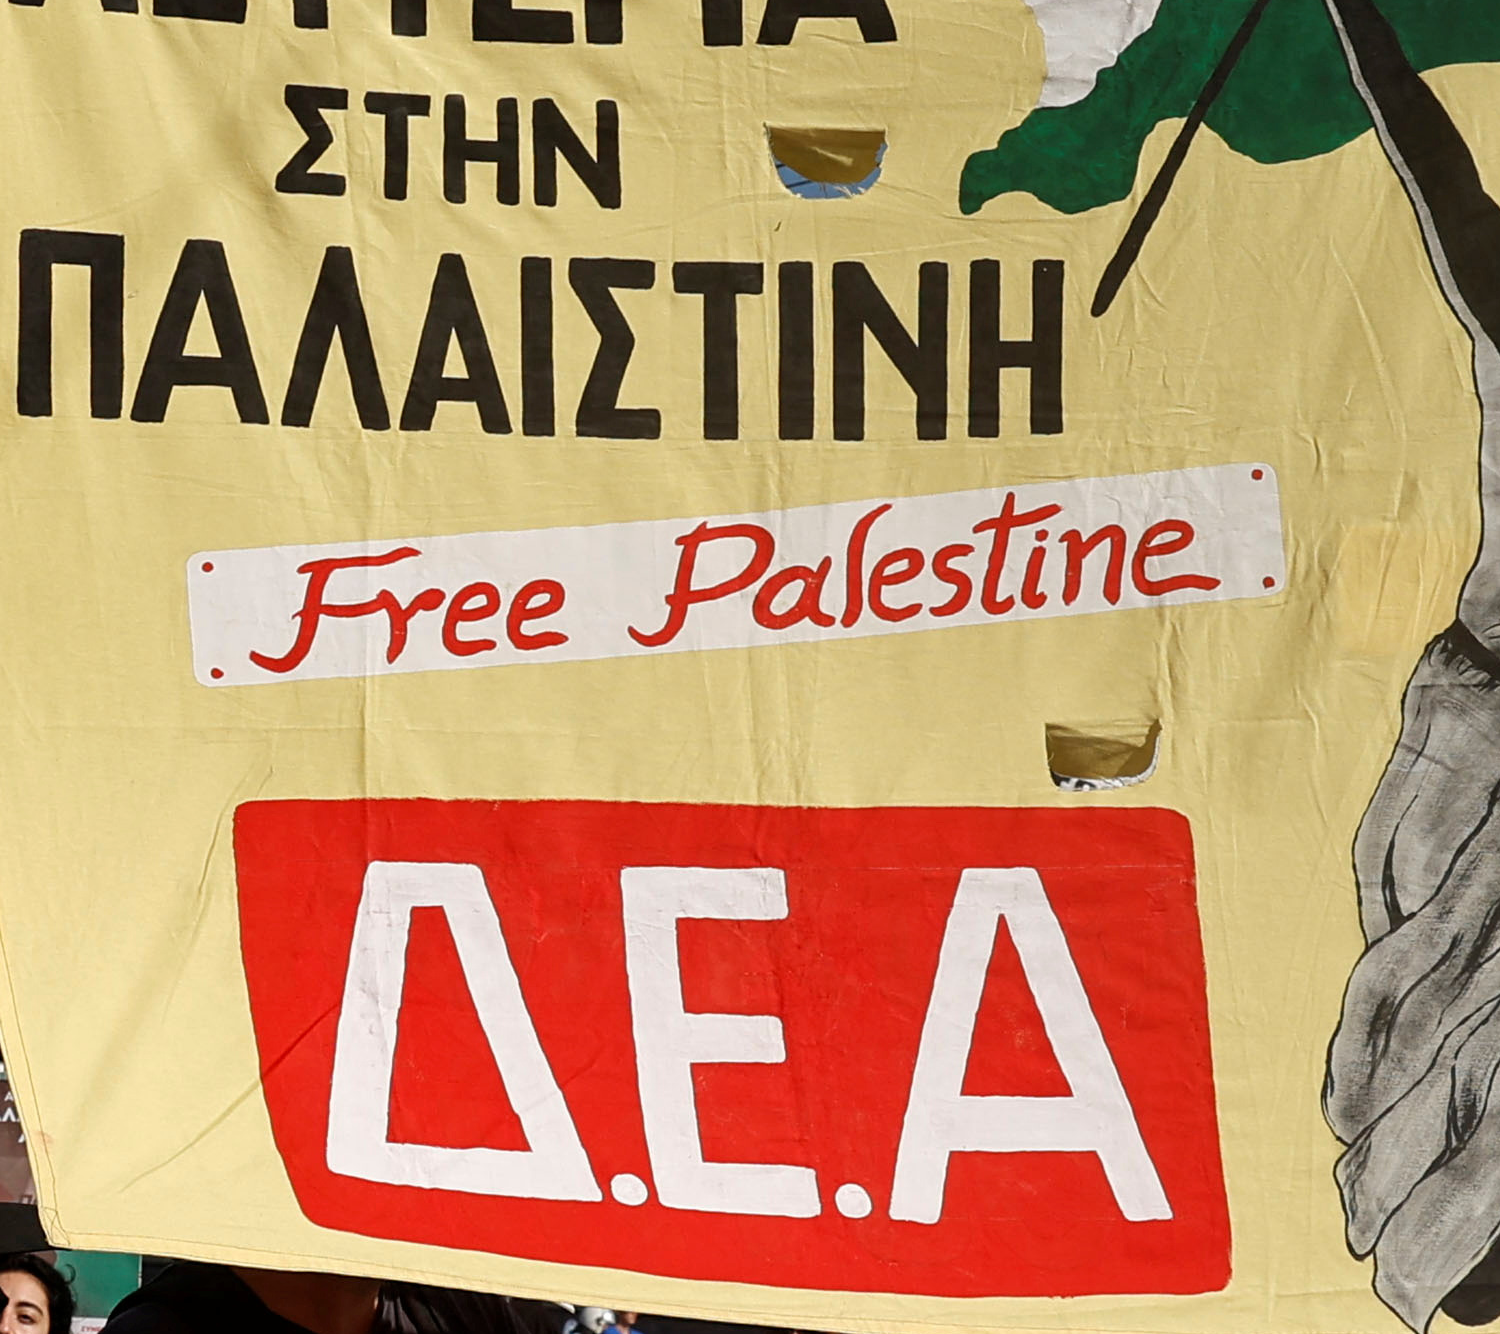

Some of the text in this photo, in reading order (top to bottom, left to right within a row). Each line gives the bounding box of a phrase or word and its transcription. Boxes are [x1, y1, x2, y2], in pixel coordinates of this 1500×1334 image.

[275, 85, 621, 209] ΣΤΗΝ
[17, 229, 1064, 441] ΠΑΛΑΙΣΤΙΝΗ
[250, 493, 1220, 672] Free Palestine
